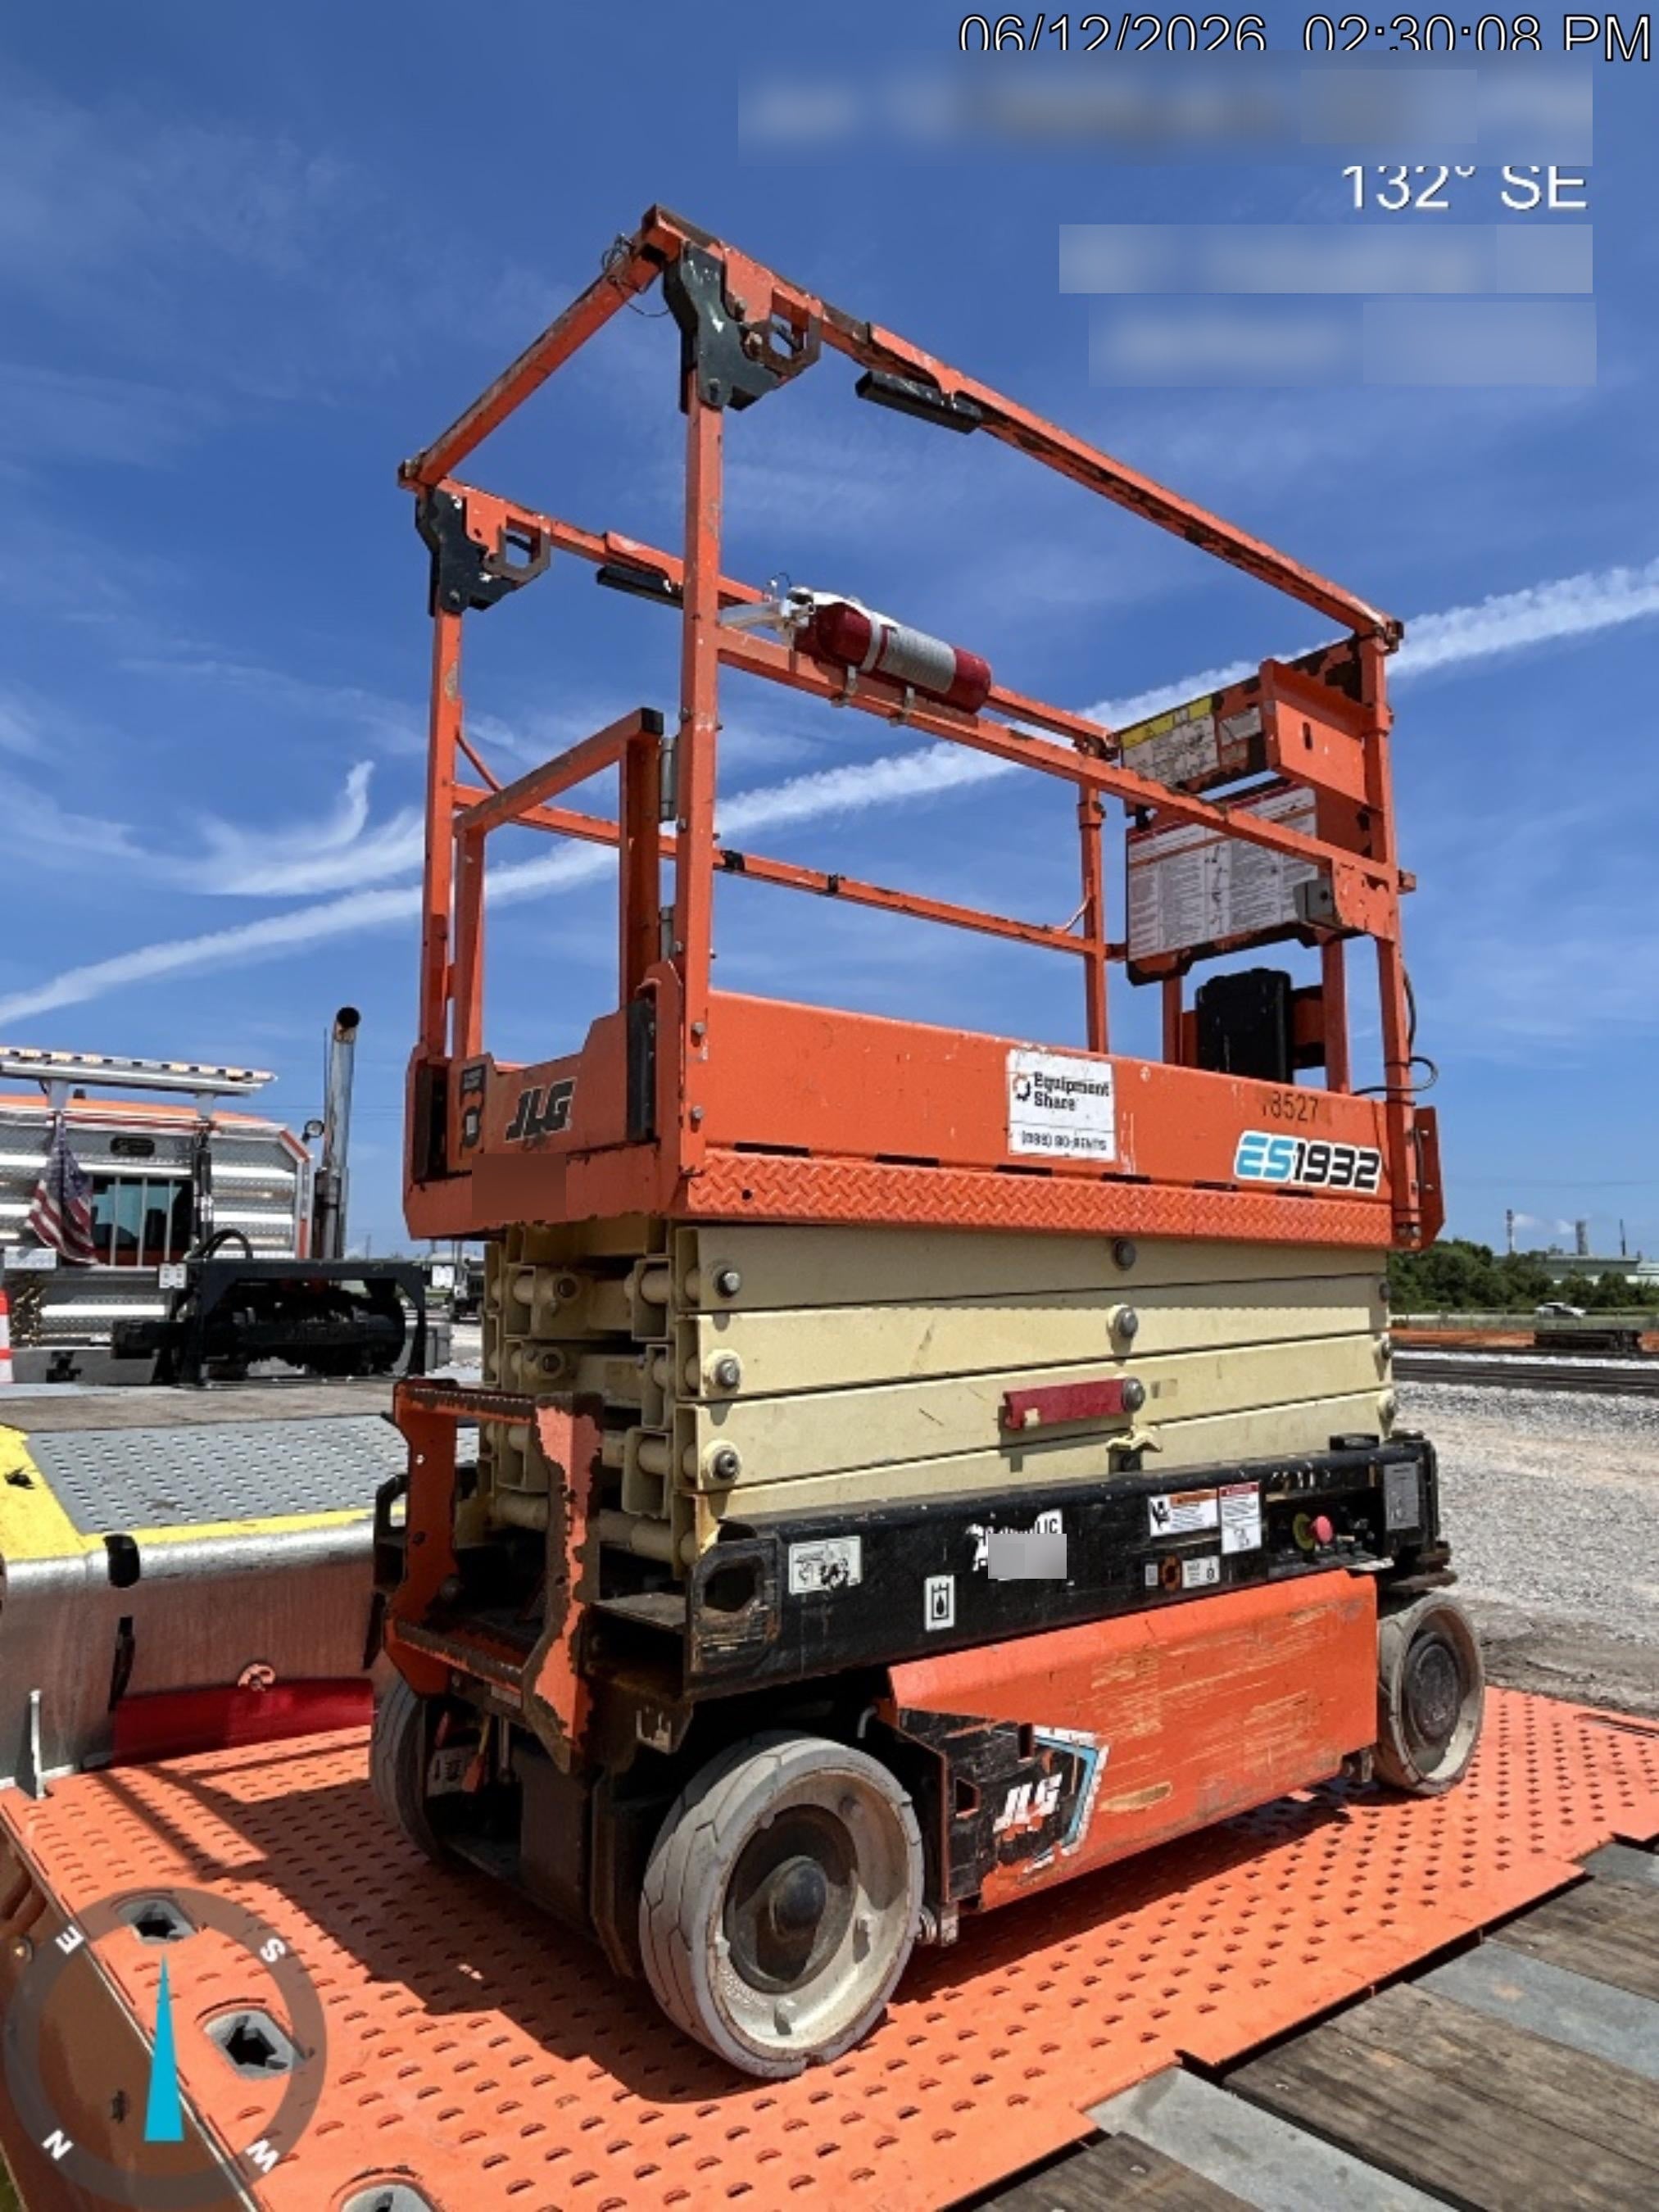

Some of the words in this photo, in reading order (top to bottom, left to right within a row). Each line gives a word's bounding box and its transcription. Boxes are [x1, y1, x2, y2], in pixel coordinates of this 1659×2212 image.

[505, 1077, 577, 1143] JLG
[1033, 1071, 1109, 1097] Equipment
[1034, 1091, 1076, 1112] Share
[1235, 1133, 1380, 1191] ES1932
[992, 1773, 1063, 1833] JLG
